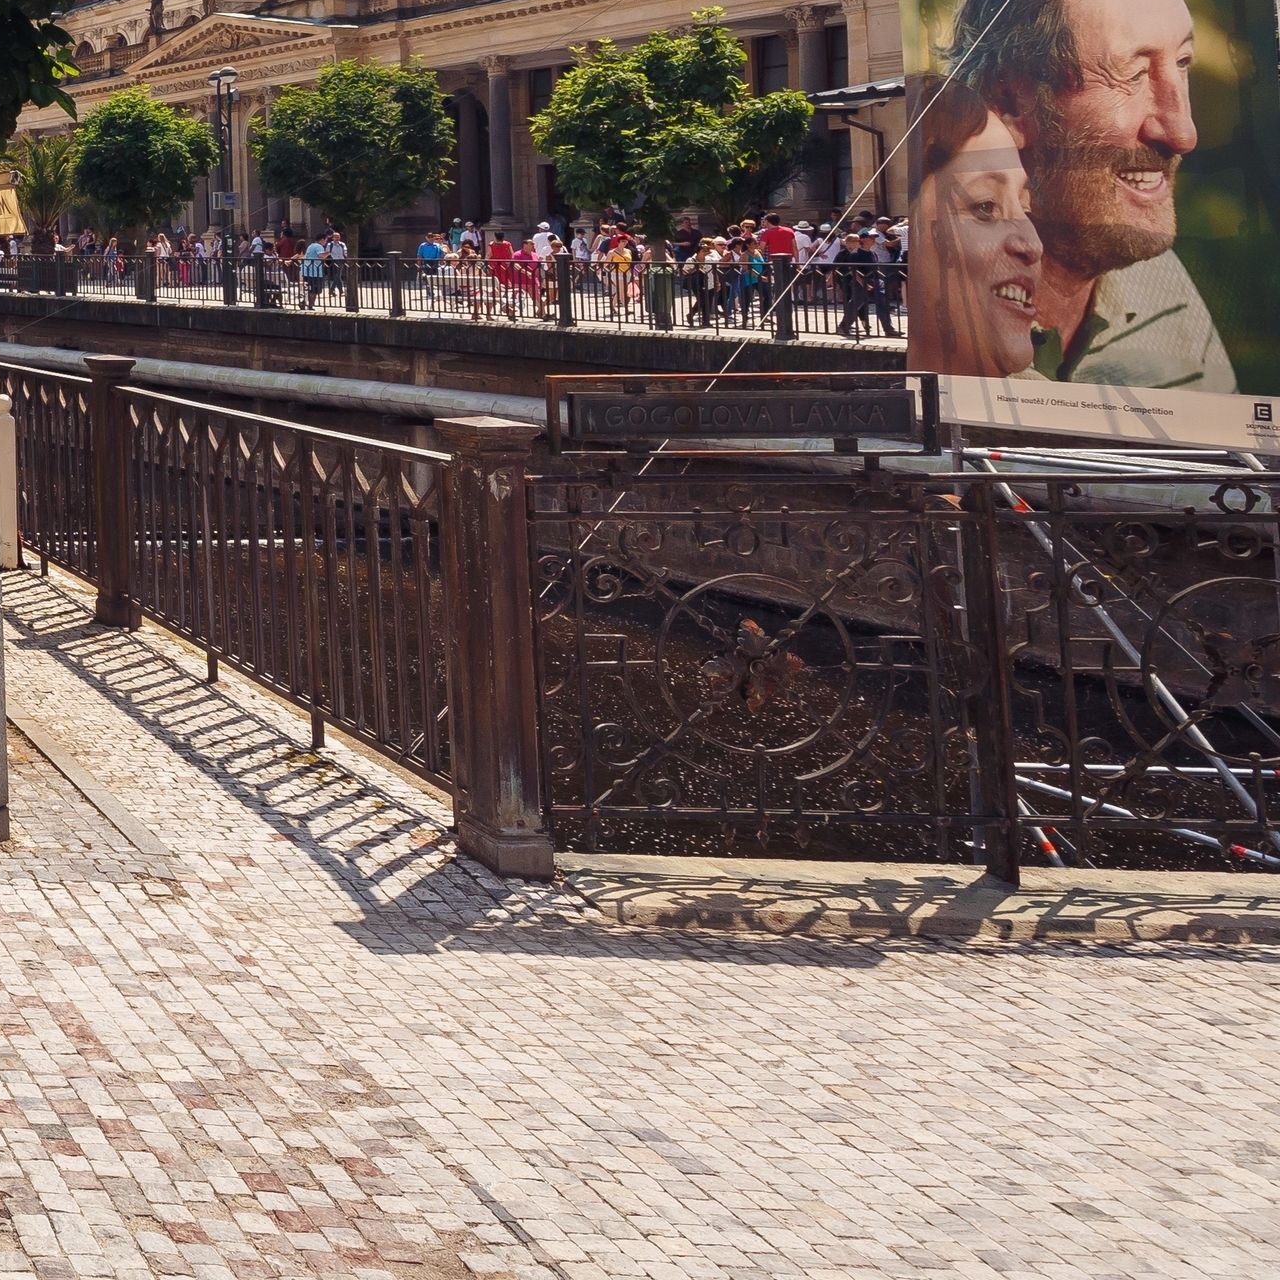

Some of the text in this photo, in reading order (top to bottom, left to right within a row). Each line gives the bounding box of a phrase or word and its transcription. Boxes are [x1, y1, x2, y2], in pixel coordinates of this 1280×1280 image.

[1051, 399, 1078, 408] Official
[604, 401, 886, 428] GOGOLOVA LÁVKA
